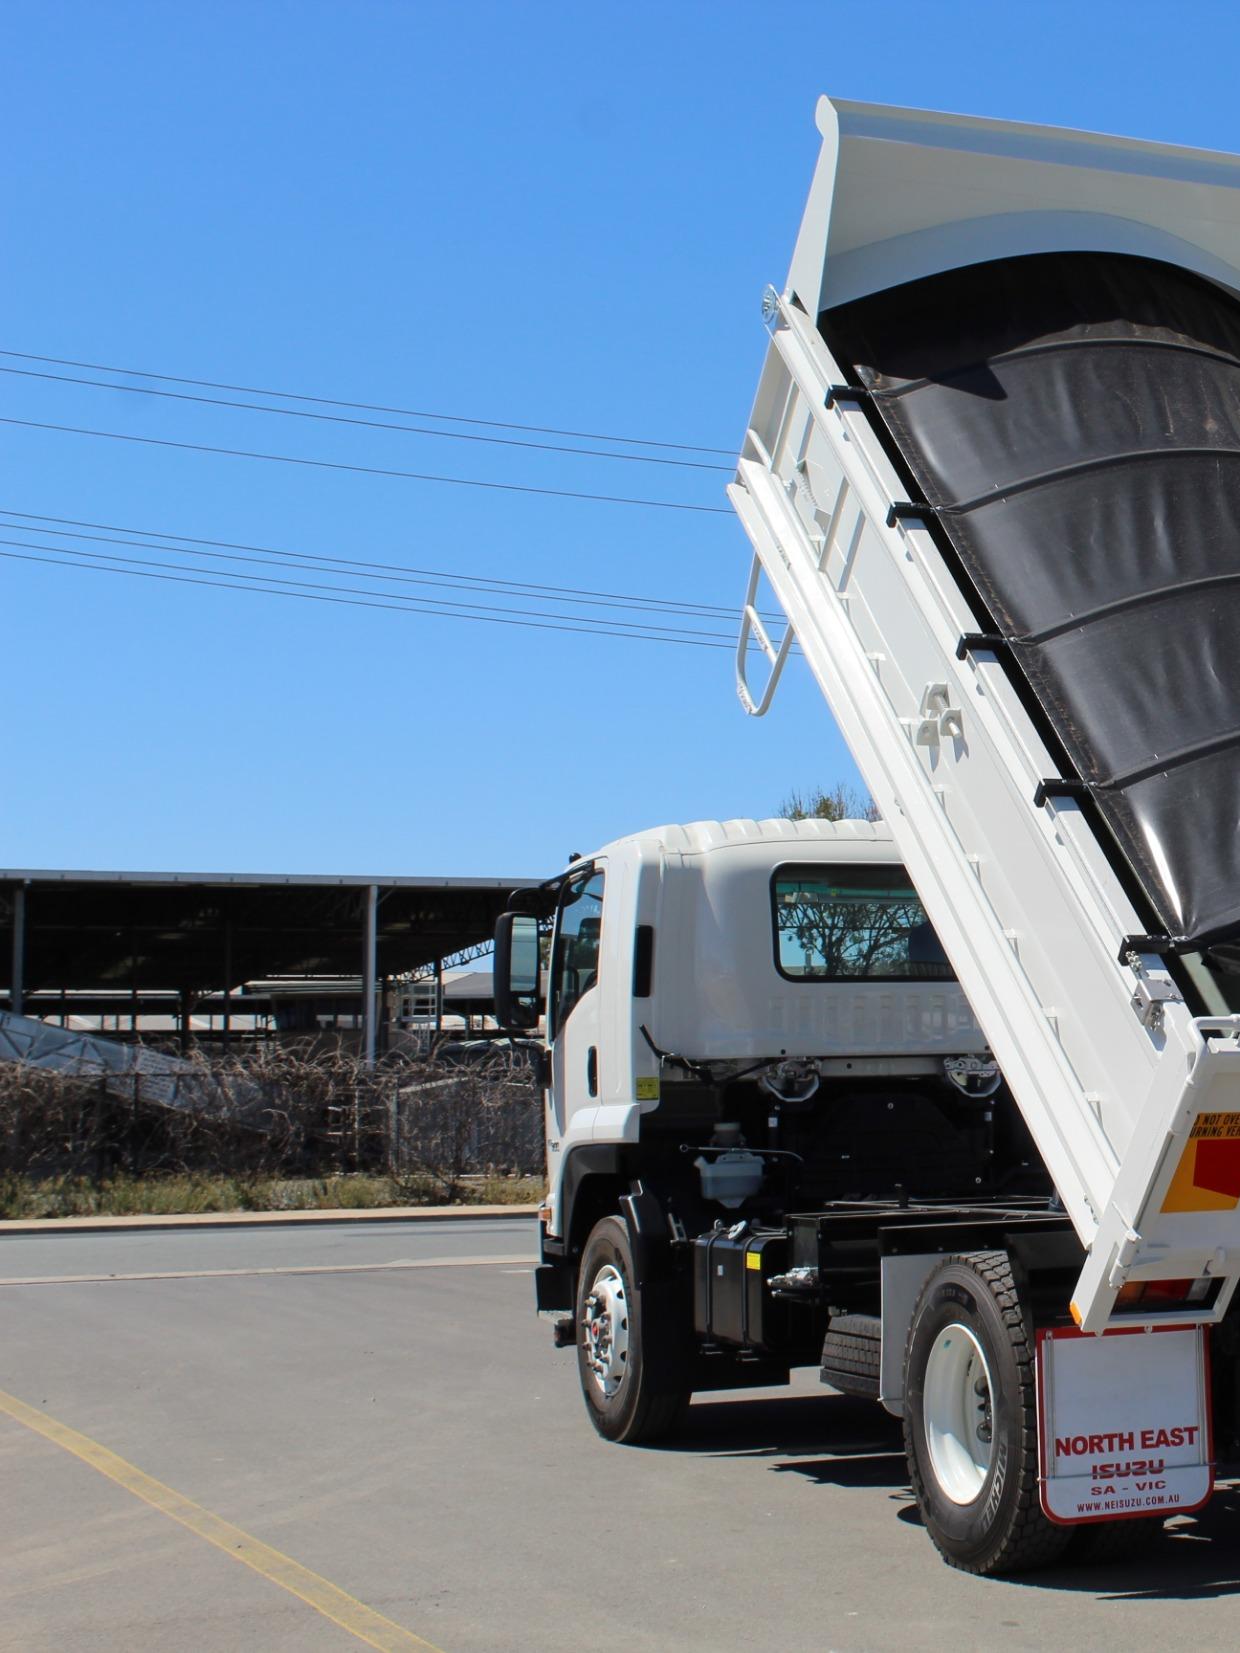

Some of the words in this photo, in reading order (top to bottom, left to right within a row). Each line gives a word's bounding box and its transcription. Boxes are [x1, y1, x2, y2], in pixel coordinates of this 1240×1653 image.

[1202, 1113, 1222, 1125] NOT
[1189, 1125, 1223, 1138] URNING
[1055, 1431, 1135, 1457] NORTH
[1140, 1426, 1200, 1450] EAST
[1091, 1458, 1165, 1480] ISUZU
[1091, 1484, 1116, 1496] SA
[1135, 1480, 1167, 1492] VIC
[1077, 1493, 1180, 1513] WWW.NEISUZU.COM.AU
